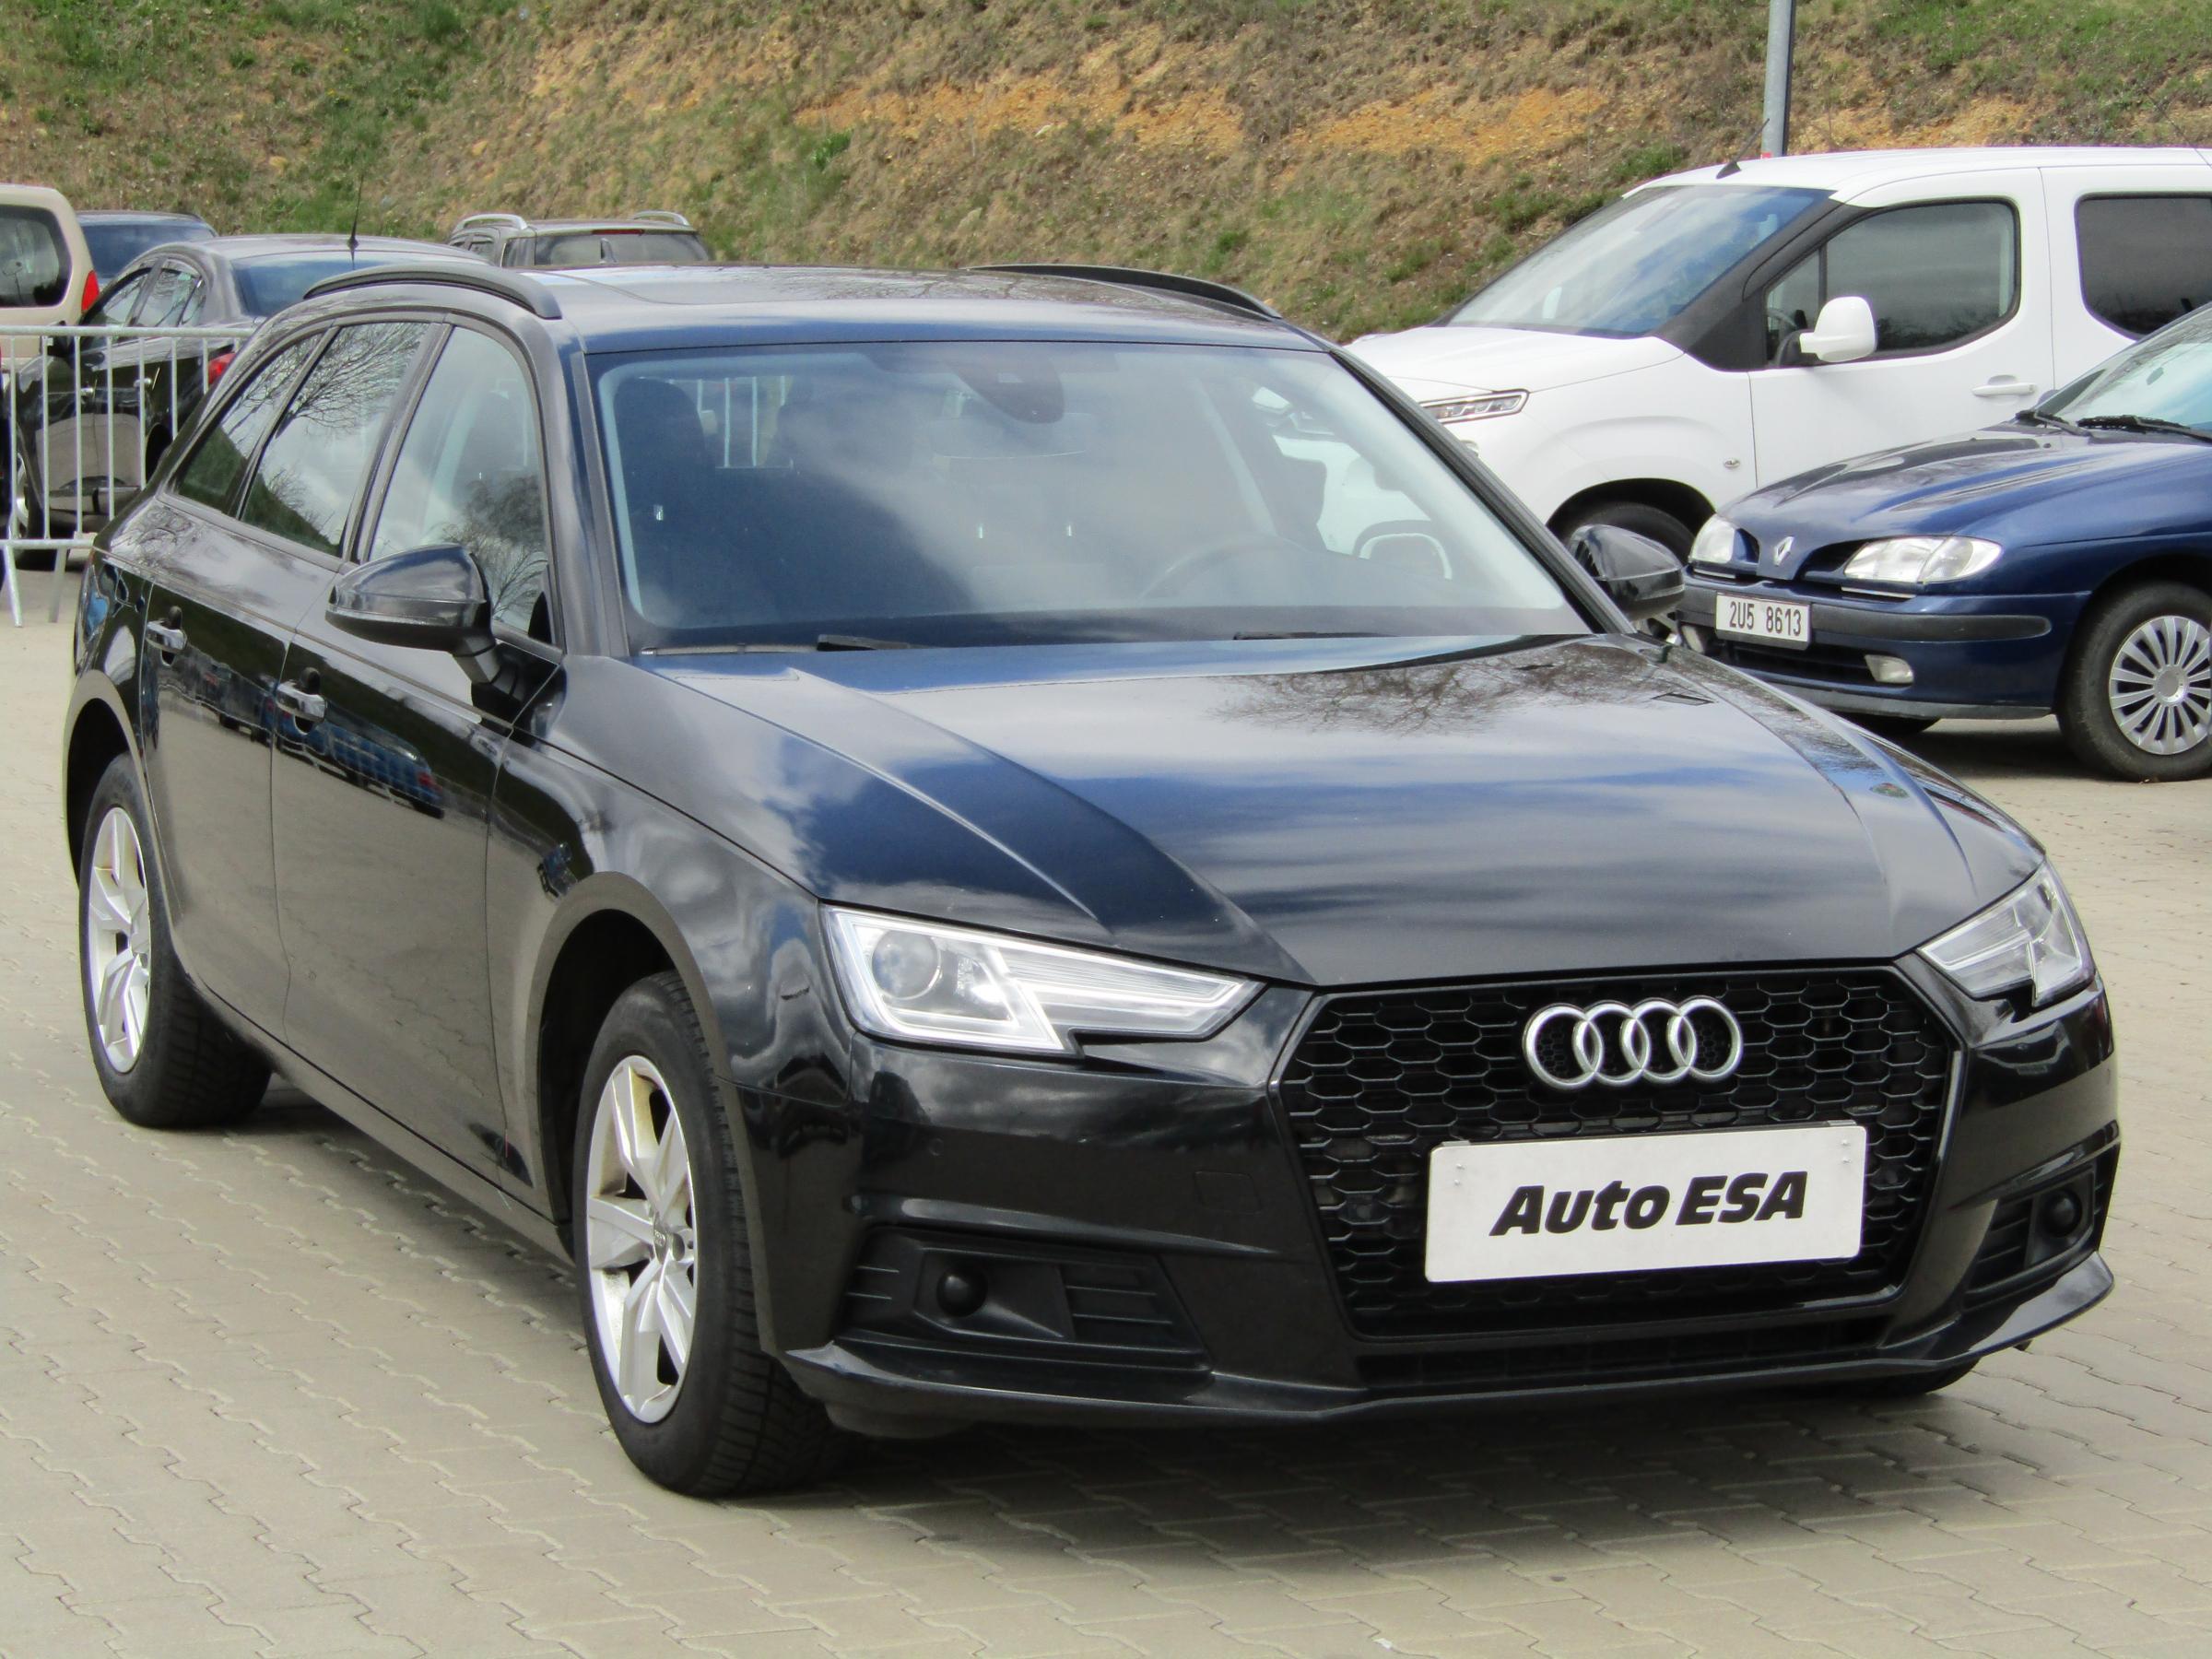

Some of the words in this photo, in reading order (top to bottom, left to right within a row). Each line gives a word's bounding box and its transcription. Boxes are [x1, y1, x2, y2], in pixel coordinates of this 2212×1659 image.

[1729, 601, 1755, 630] 2U5
[1765, 606, 1802, 637] 8613
[1488, 1181, 1670, 1236] Auto
[1675, 1171, 1807, 1226] ESA
